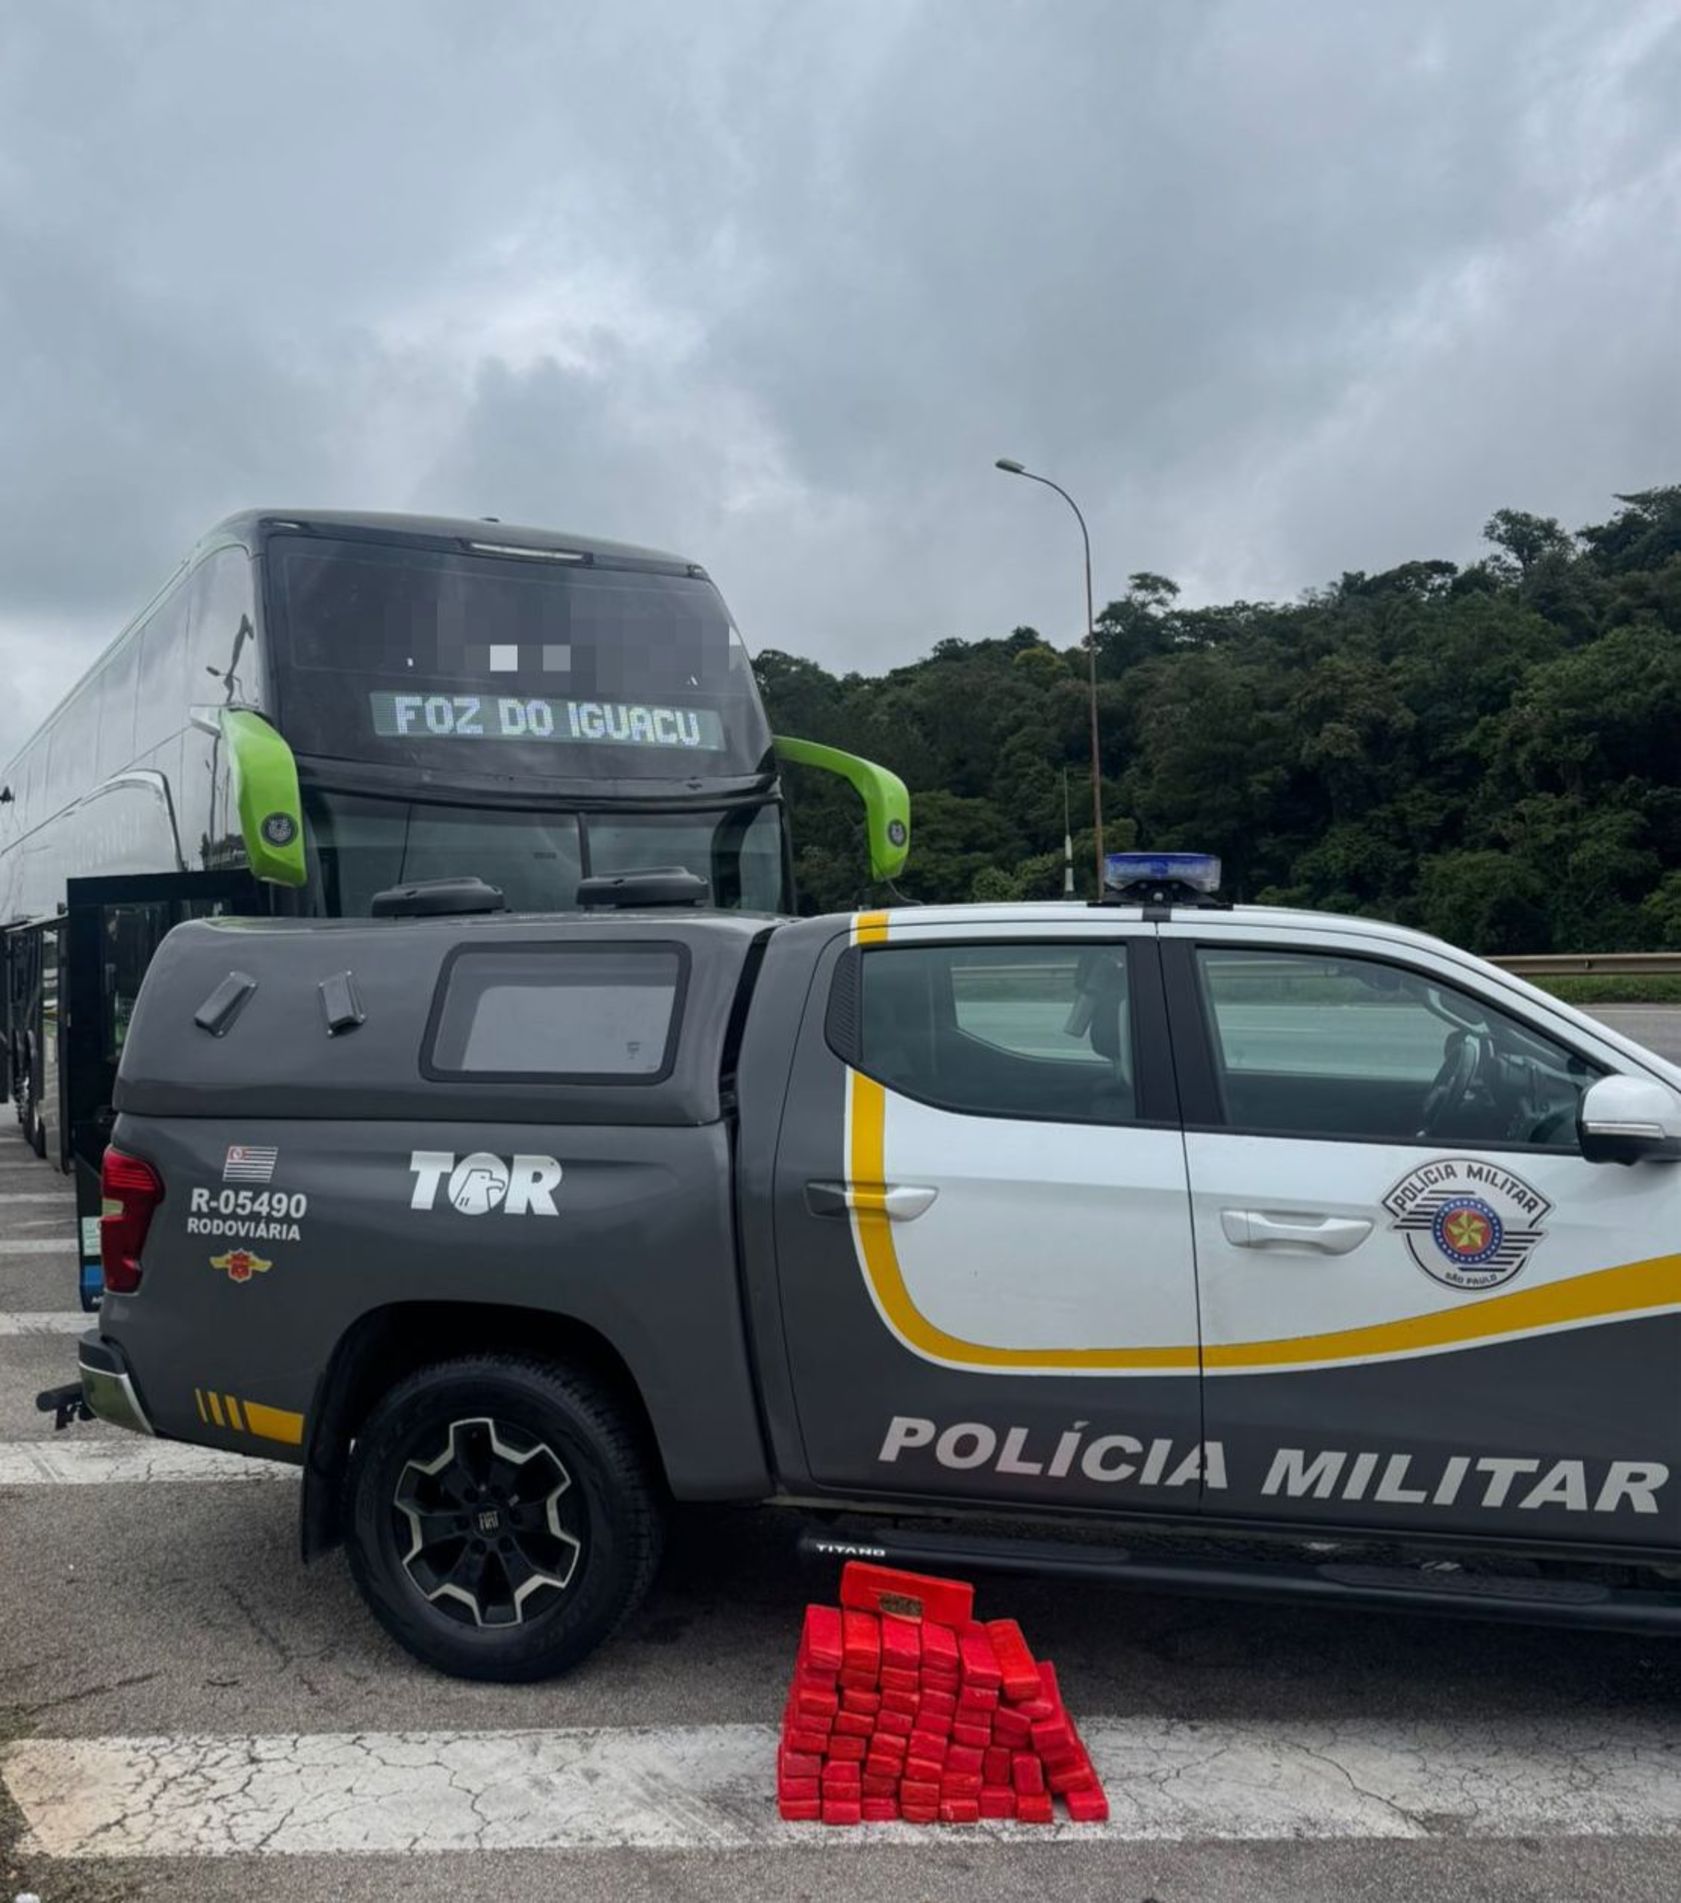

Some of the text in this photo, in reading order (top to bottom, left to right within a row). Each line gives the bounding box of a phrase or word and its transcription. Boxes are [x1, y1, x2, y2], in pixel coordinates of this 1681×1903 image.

[394, 696, 701, 746] FOZ DO IGUACU
[190, 1187, 307, 1219] R-05490
[409, 1150, 563, 1216] TOR
[1392, 1164, 1540, 1214] POLÍCIA MILITAR
[187, 1217, 301, 1241] RODOVIÁRIA
[1445, 1271, 1498, 1285] SÃO PAULO
[878, 1415, 1671, 1515] POLÍCIA MILITAR
[816, 1543, 886, 1557] TITANO
